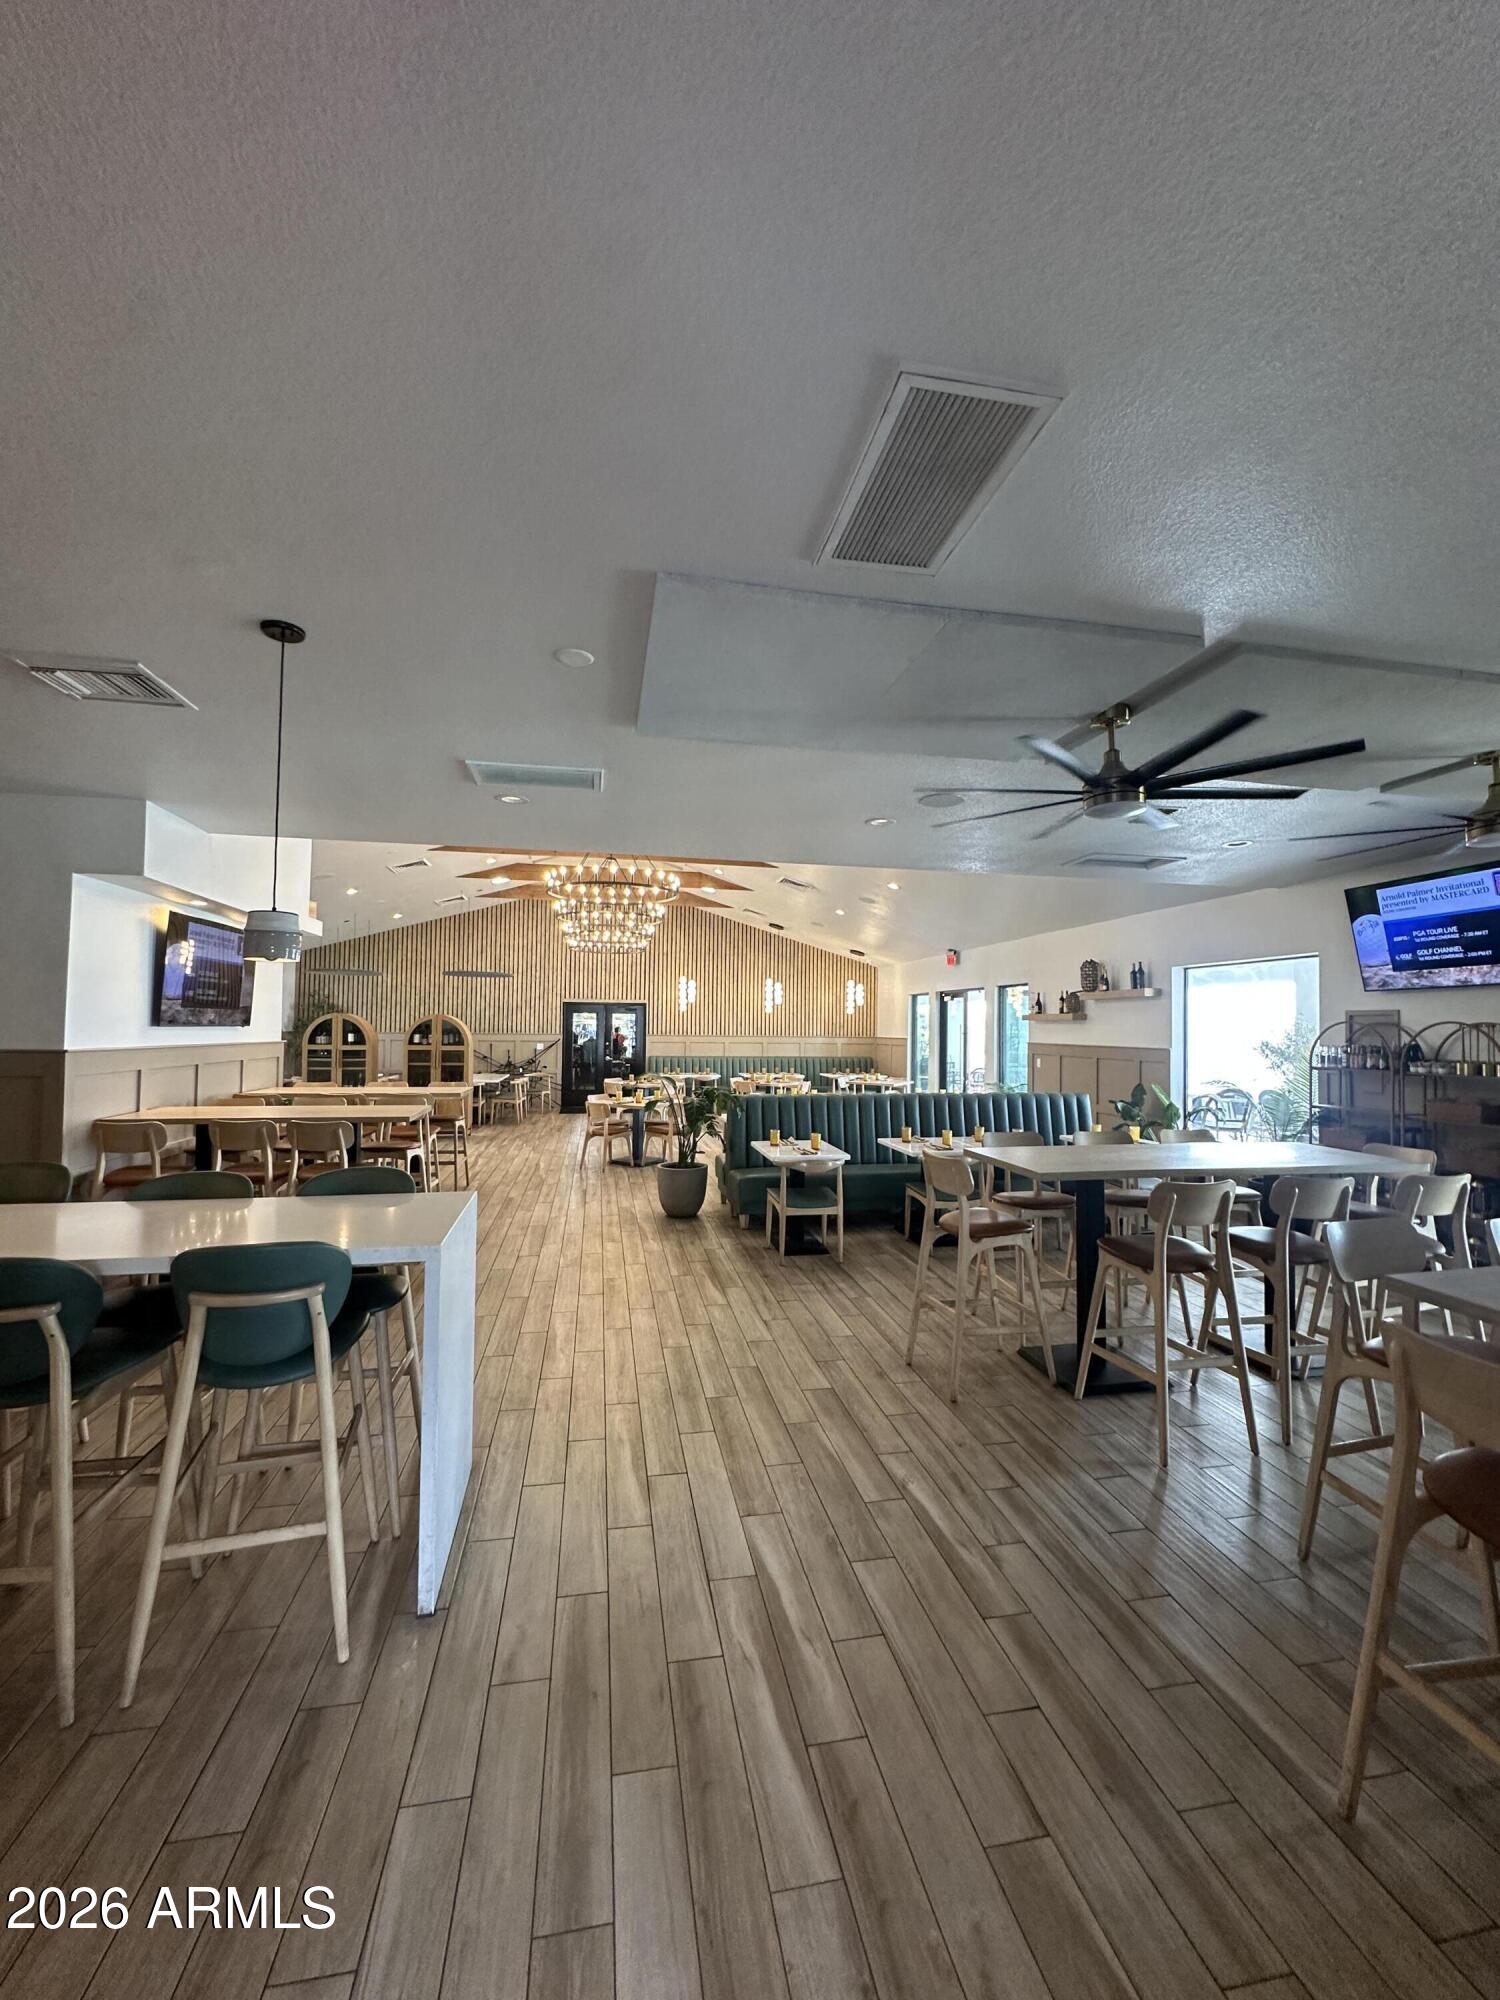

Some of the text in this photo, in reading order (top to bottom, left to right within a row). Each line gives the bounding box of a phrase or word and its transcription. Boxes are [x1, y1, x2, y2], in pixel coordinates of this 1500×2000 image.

[1381, 878, 1485, 902] Arnold Palmer Invitational
[1382, 897, 1418, 910] presented
[1419, 896, 1429, 904] by
[1431, 885, 1490, 901] MASTERCARD
[1412, 925, 1459, 937] PGA TOUR LIVE
[1416, 945, 1465, 956] GOLF CHANNEL
